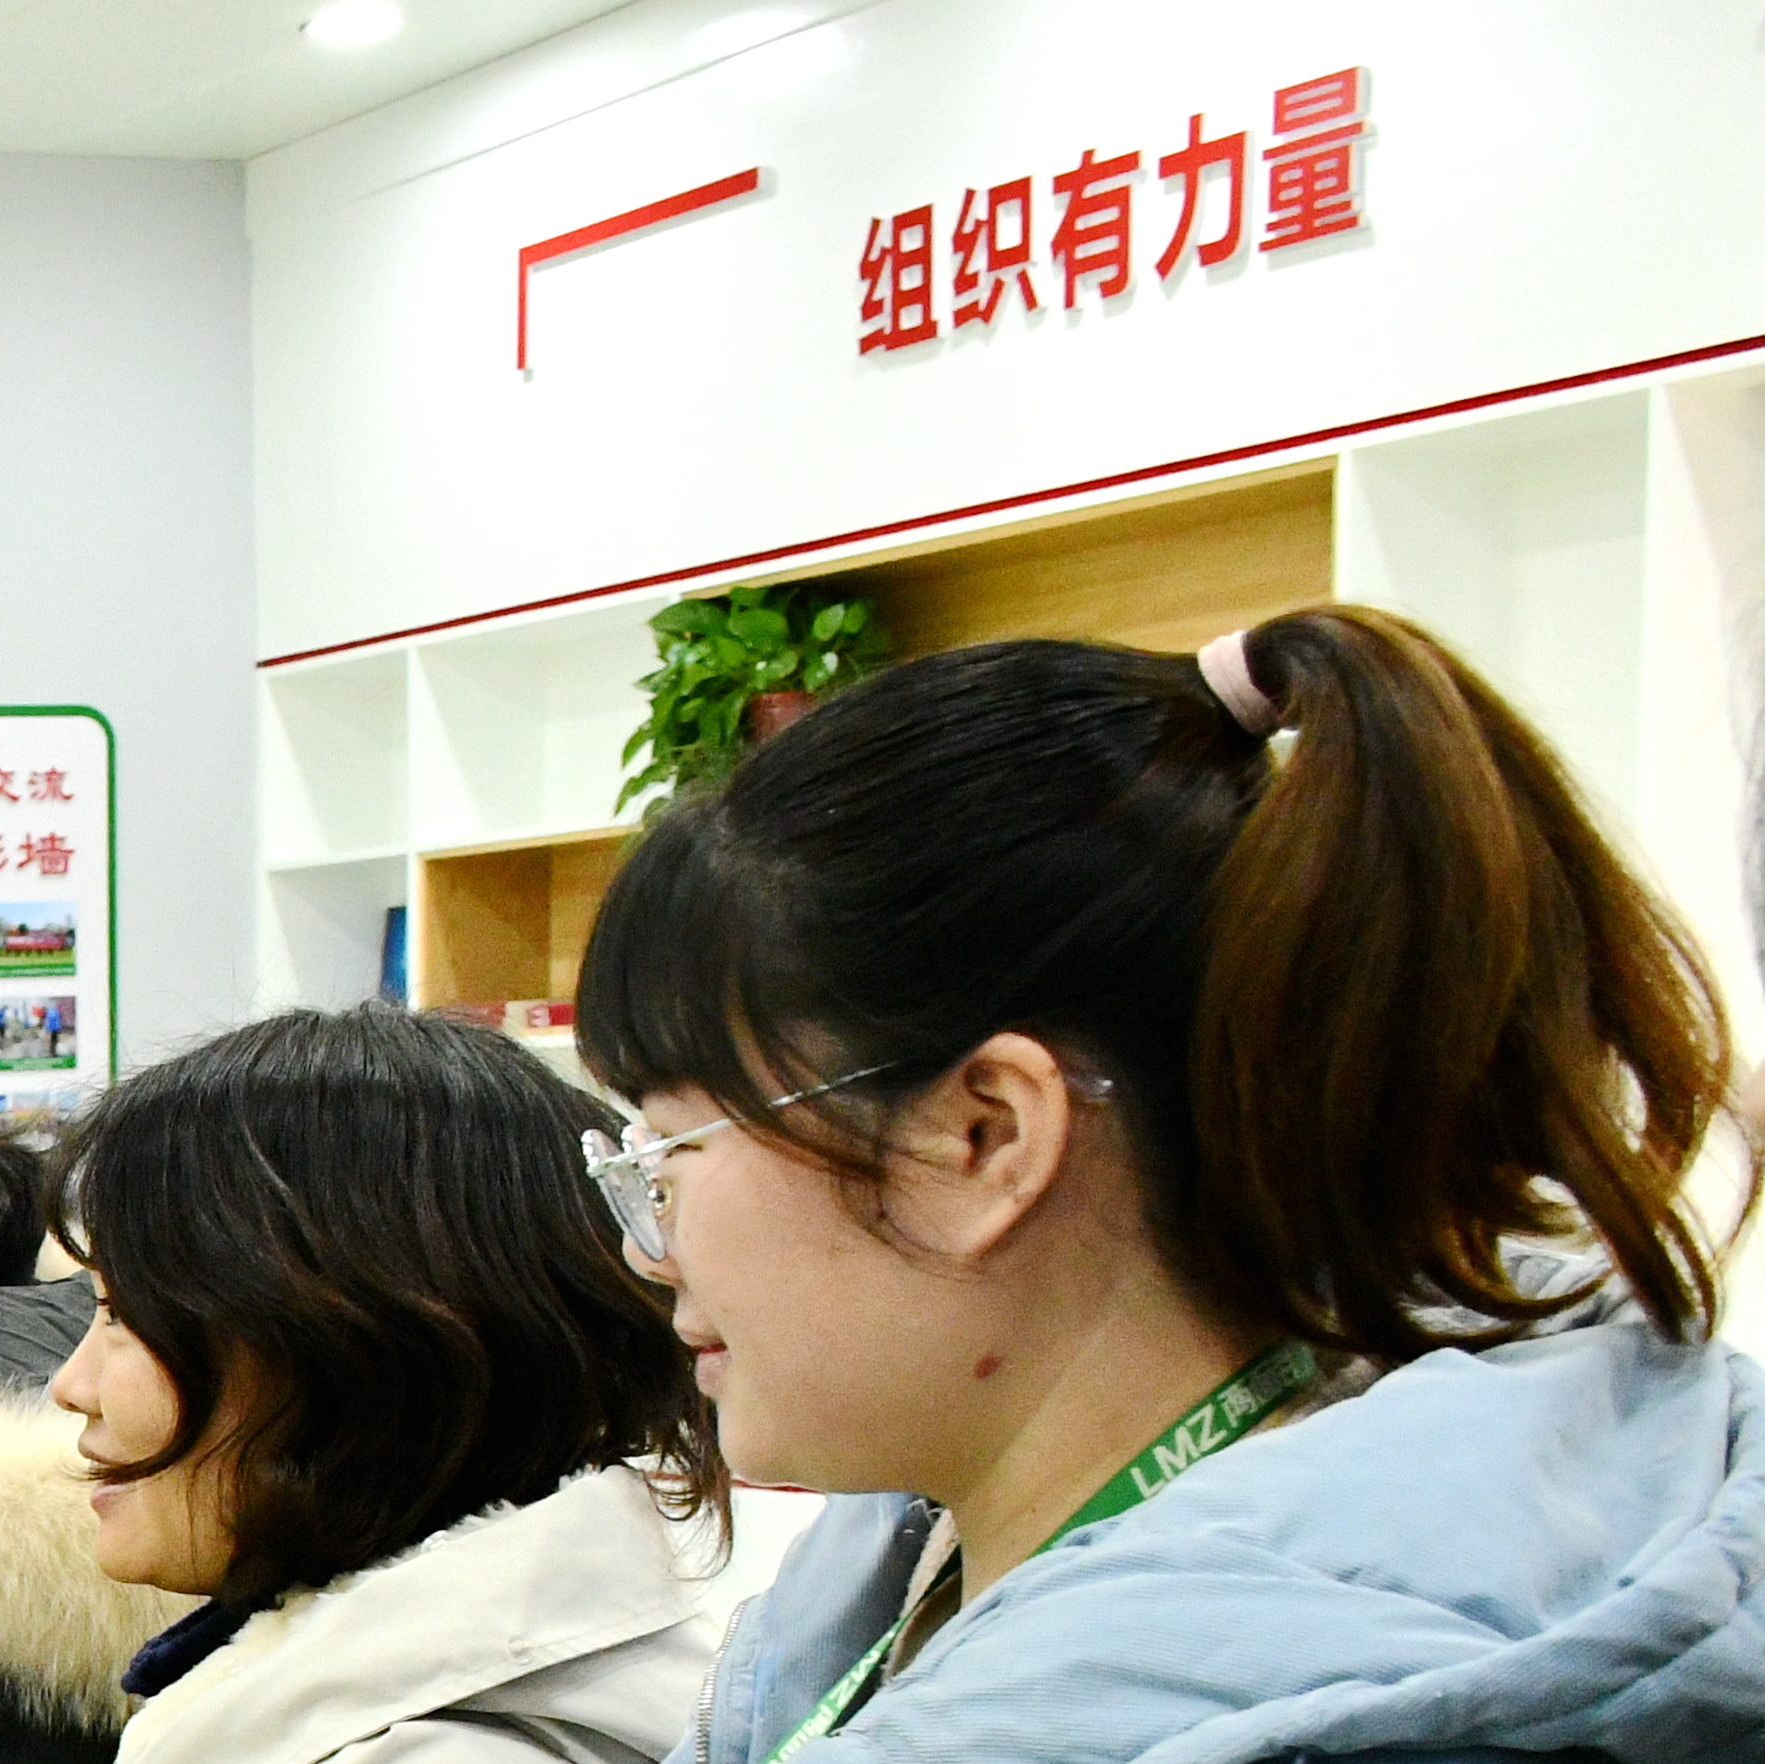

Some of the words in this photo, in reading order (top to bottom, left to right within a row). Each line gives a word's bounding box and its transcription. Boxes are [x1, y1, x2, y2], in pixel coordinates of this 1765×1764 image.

[857, 65, 1369, 356] 组织有力量
[1130, 1404, 1228, 1497] LMZ
